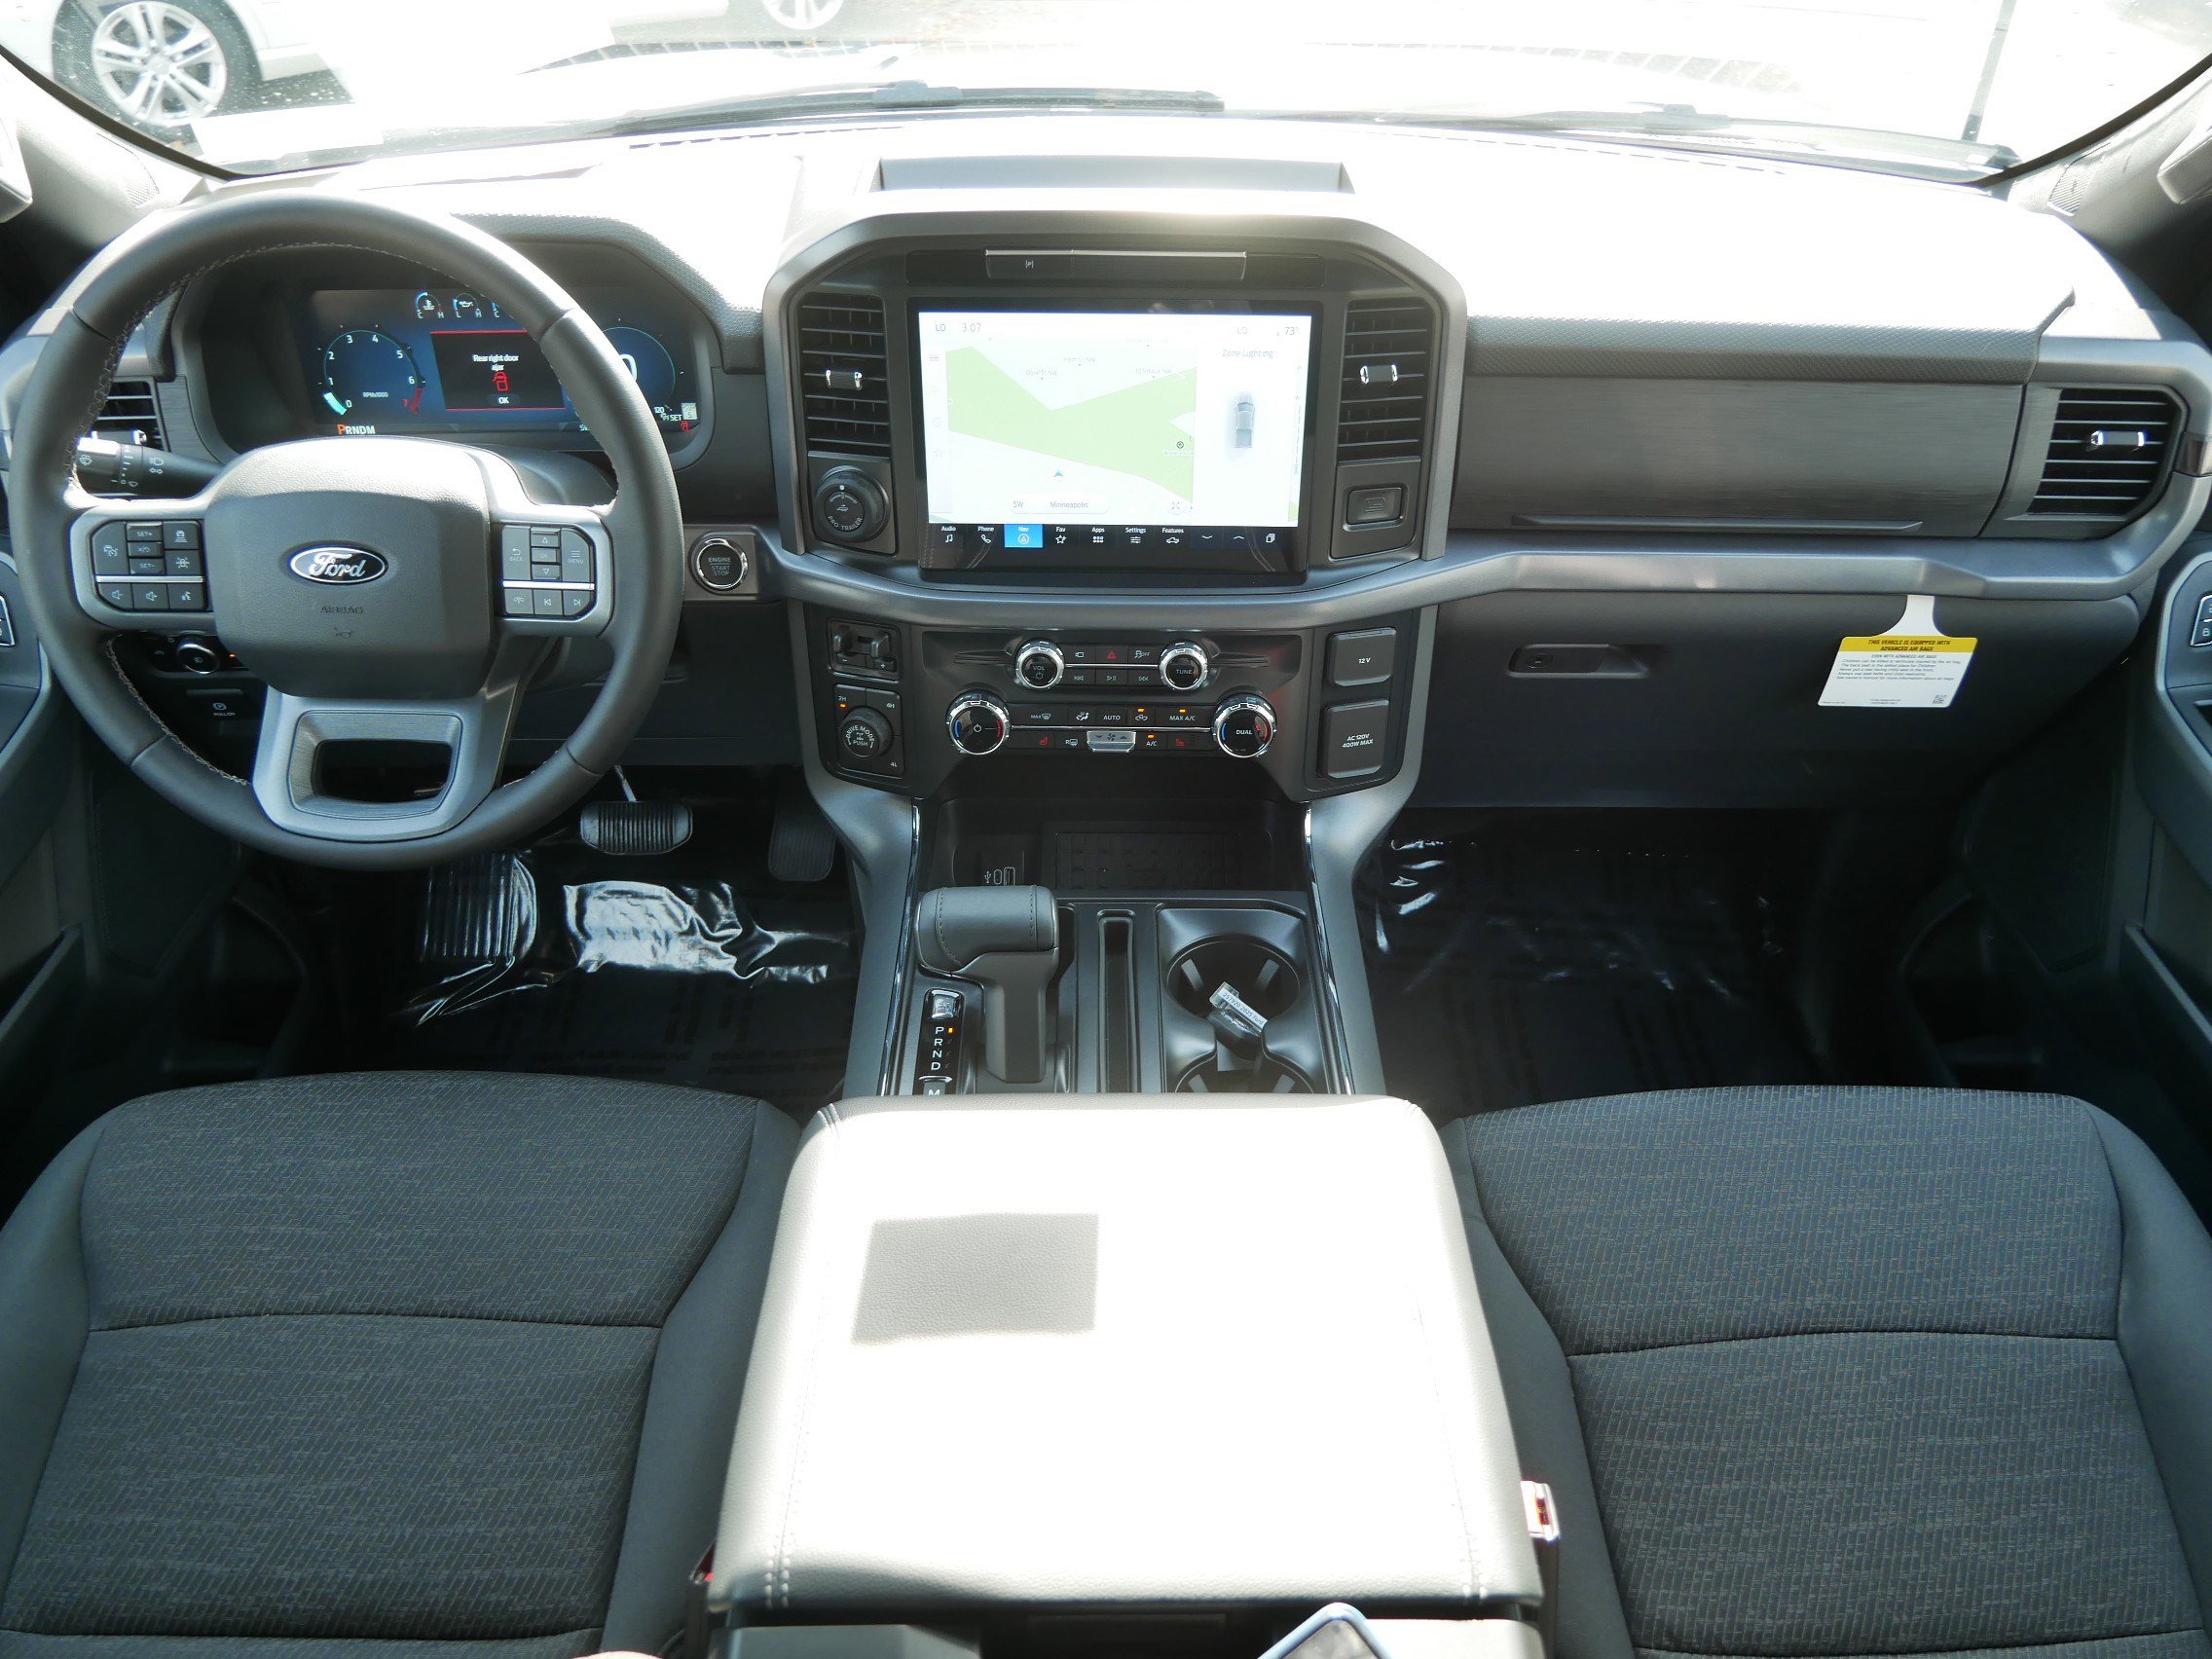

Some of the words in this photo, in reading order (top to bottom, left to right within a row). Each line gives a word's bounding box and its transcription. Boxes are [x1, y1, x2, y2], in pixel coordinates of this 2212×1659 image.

[935, 324, 946, 332] LO
[347, 335, 353, 343] 3
[372, 334, 379, 343] 4
[328, 351, 335, 360] 2
[397, 350, 404, 359] 5
[489, 354, 503, 363] right
[1222, 349, 1241, 357] Zone
[1242, 349, 1273, 359] Lighting
[329, 377, 333, 386] 1
[408, 376, 415, 384] 6
[345, 400, 352, 408] 0
[828, 516, 839, 527] PRO
[841, 517, 863, 530] TRAILER
[309, 551, 367, 577] Ford
[846, 725, 859, 738] DRIVE
[859, 726, 875, 741] MODE
[1240, 1007, 1252, 1017] 2025
[1253, 1015, 1264, 1025] Ford
[932, 1050, 942, 1058] N
[931, 1062, 941, 1070] D
